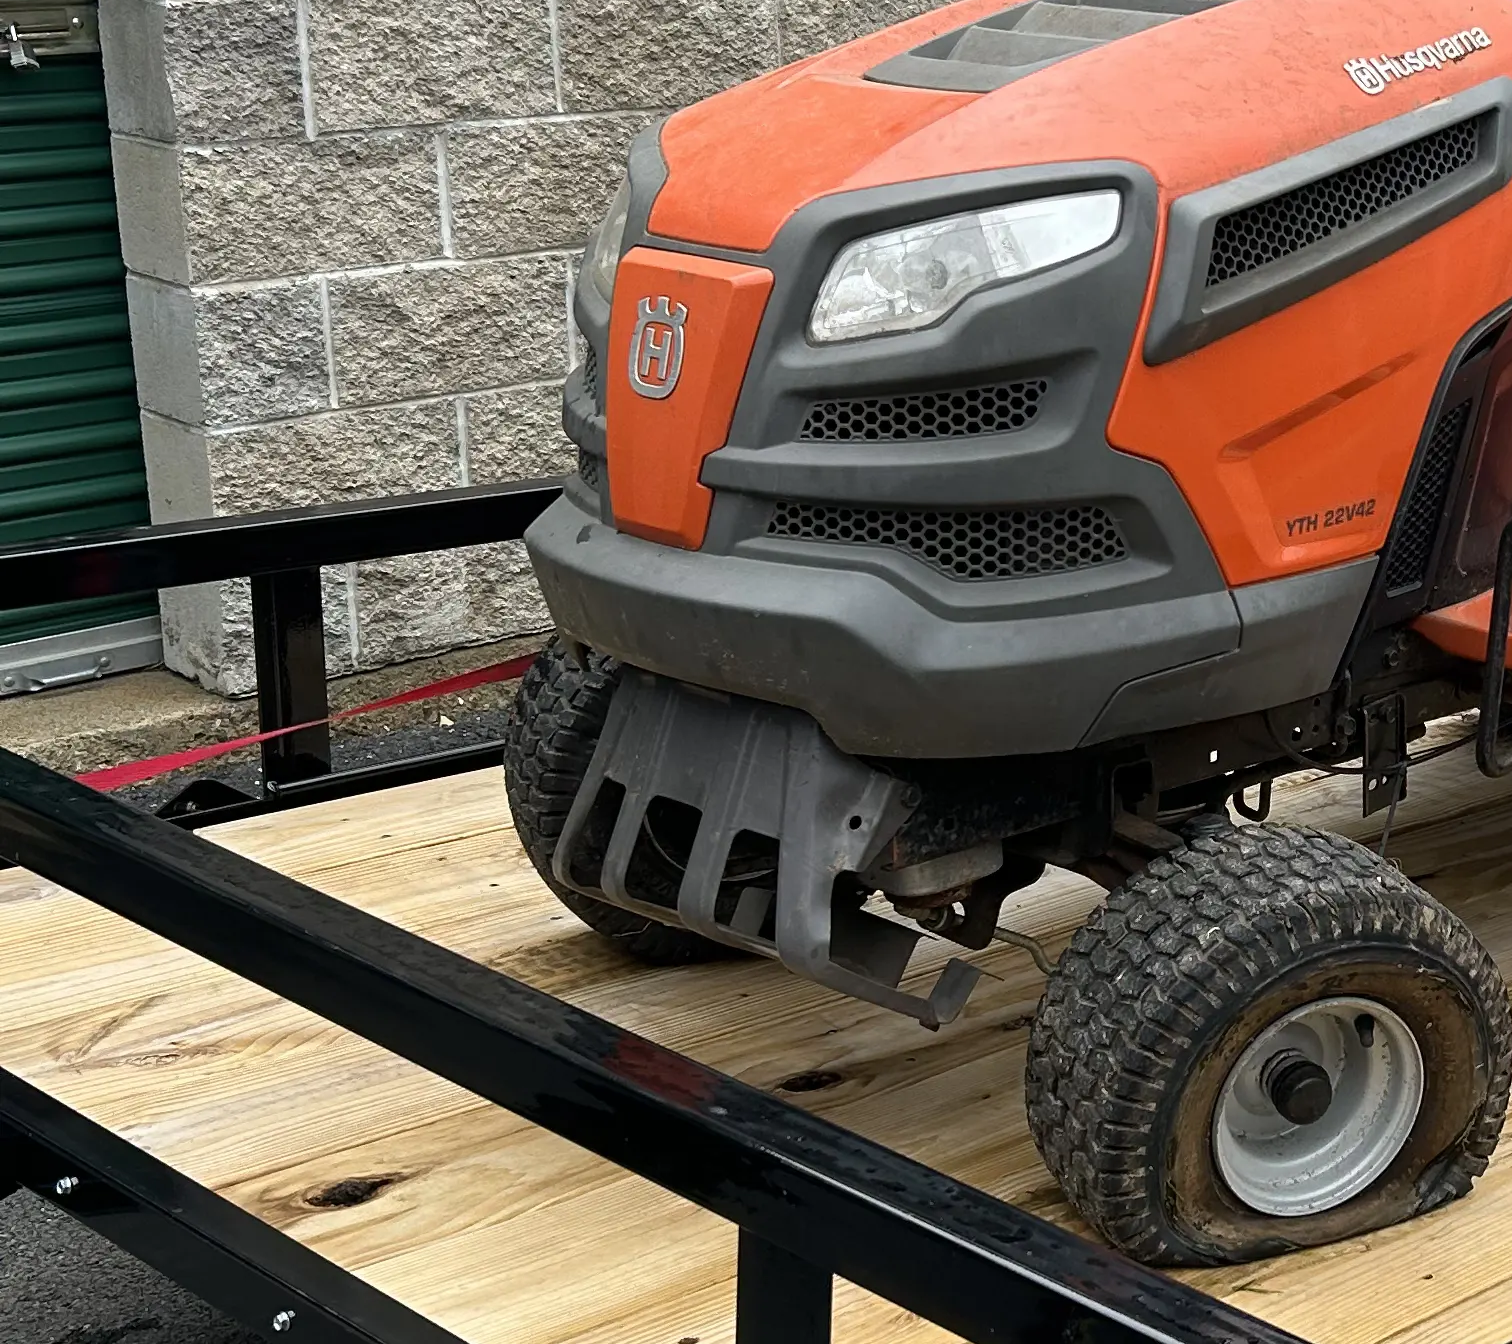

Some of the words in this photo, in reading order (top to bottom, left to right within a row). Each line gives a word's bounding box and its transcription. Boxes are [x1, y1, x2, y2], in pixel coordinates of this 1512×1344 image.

[1369, 25, 1493, 84] Husqvarna
[1286, 513, 1319, 537] YTH
[1323, 498, 1377, 529] 22V42
